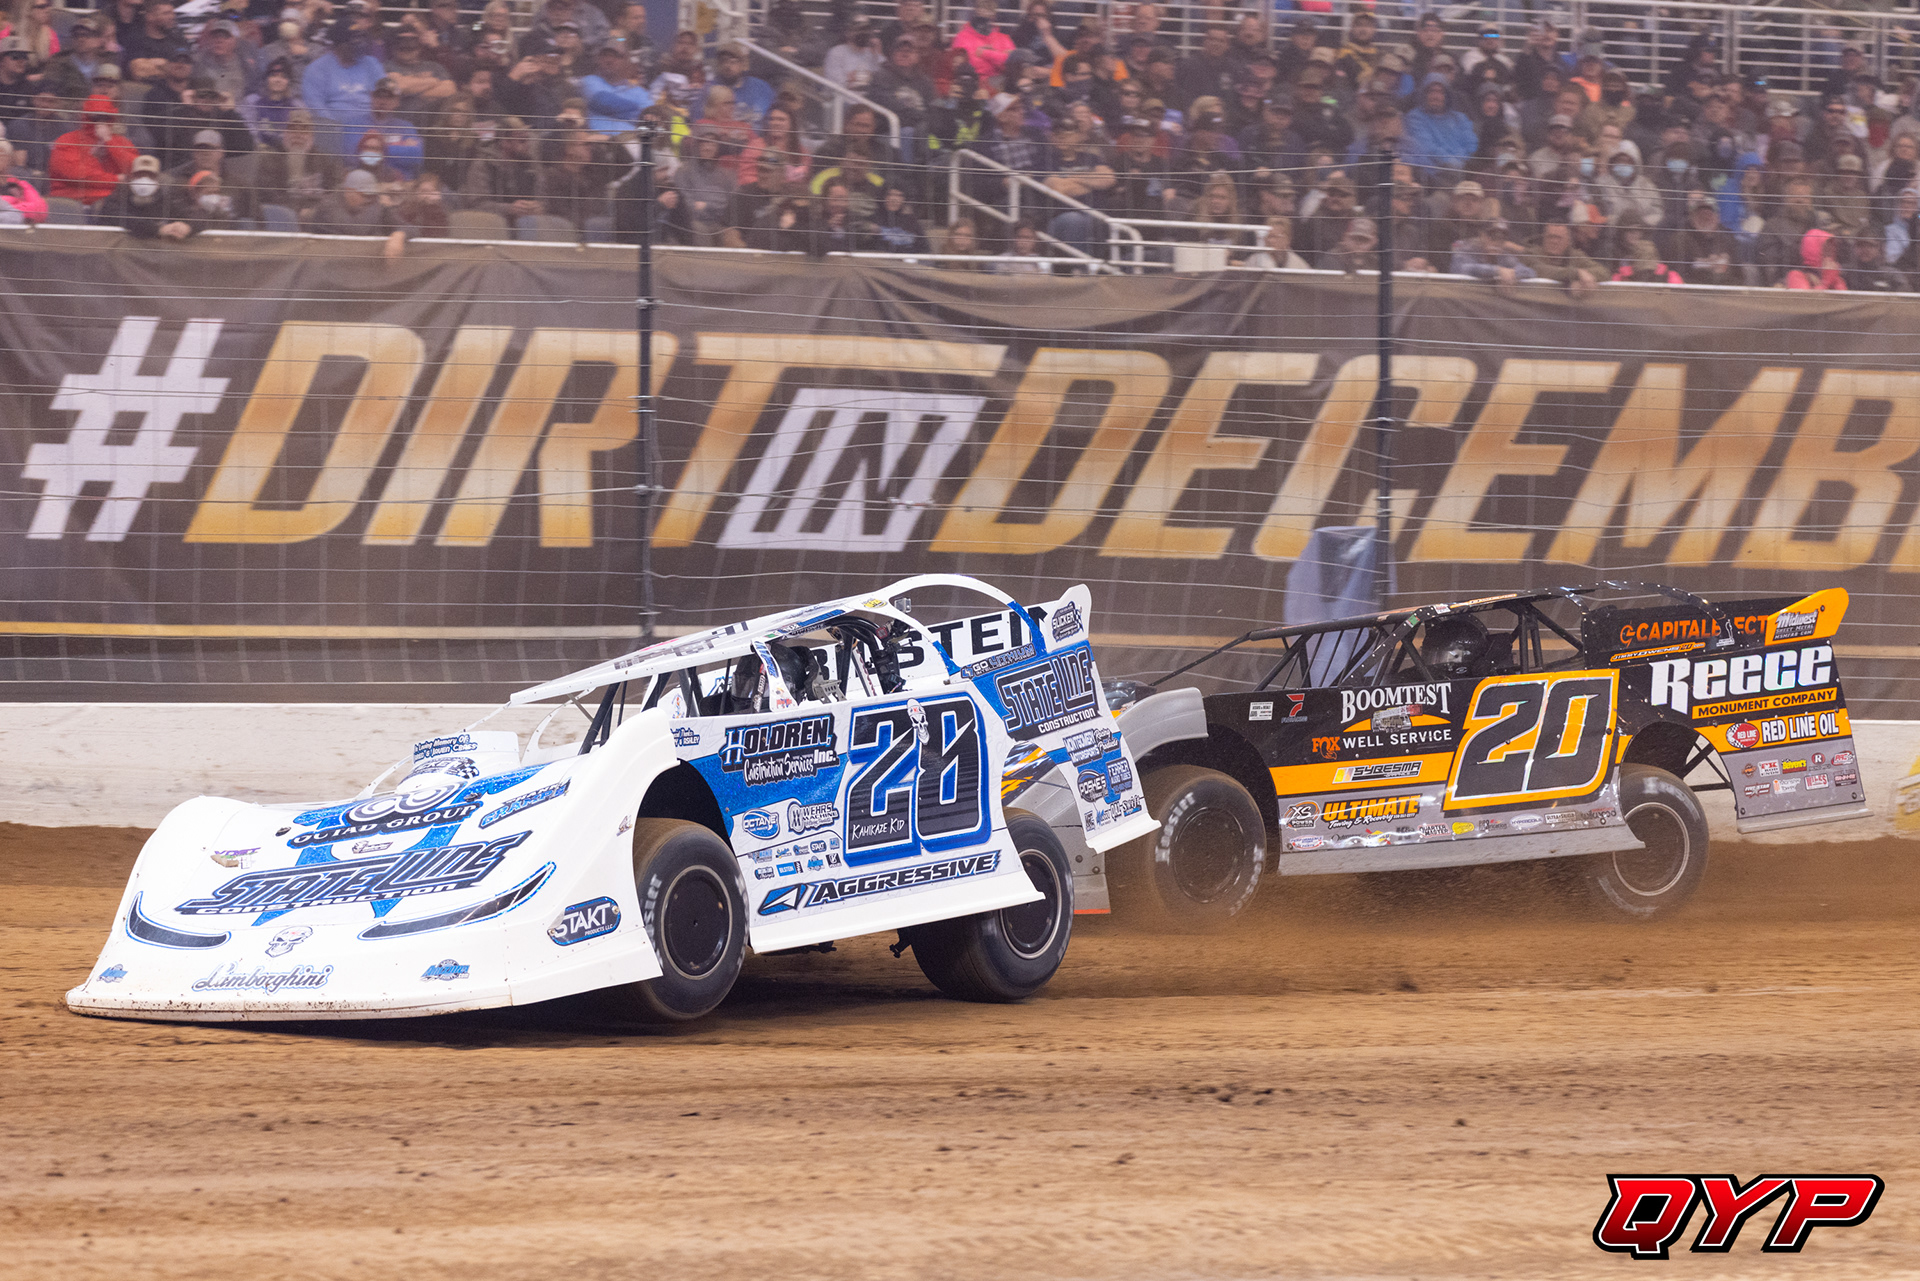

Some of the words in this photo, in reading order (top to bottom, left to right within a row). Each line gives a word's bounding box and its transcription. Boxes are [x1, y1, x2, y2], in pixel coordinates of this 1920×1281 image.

[973, 661, 989, 671] GO
[1341, 682, 1452, 724] BOOMTEST
[1698, 699, 1769, 717] MONUMENT
[1773, 689, 1834, 707] COMPANY
[1038, 708, 1096, 733] CONSTRUCTION
[1761, 720, 1786, 744] RED
[1788, 715, 1817, 740] LINE
[1819, 711, 1839, 736] OIL
[1312, 736, 1341, 759] FOX
[1343, 735, 1383, 749] WELL
[1390, 729, 1452, 745] SERVICE
[1451, 677, 1614, 801] 20
[848, 696, 984, 854] 28
[389, 803, 478, 829] GROUP
[1291, 806, 1312, 820] XS
[1323, 795, 1421, 821] ULTIMATE
[1328, 818, 1352, 829] Towing
[1365, 813, 1394, 825] Recovery
[812, 854, 998, 904] AGGRESSIVE
[196, 883, 458, 915] CONSTRUCTION
[192, 961, 333, 994] Lamborghini
